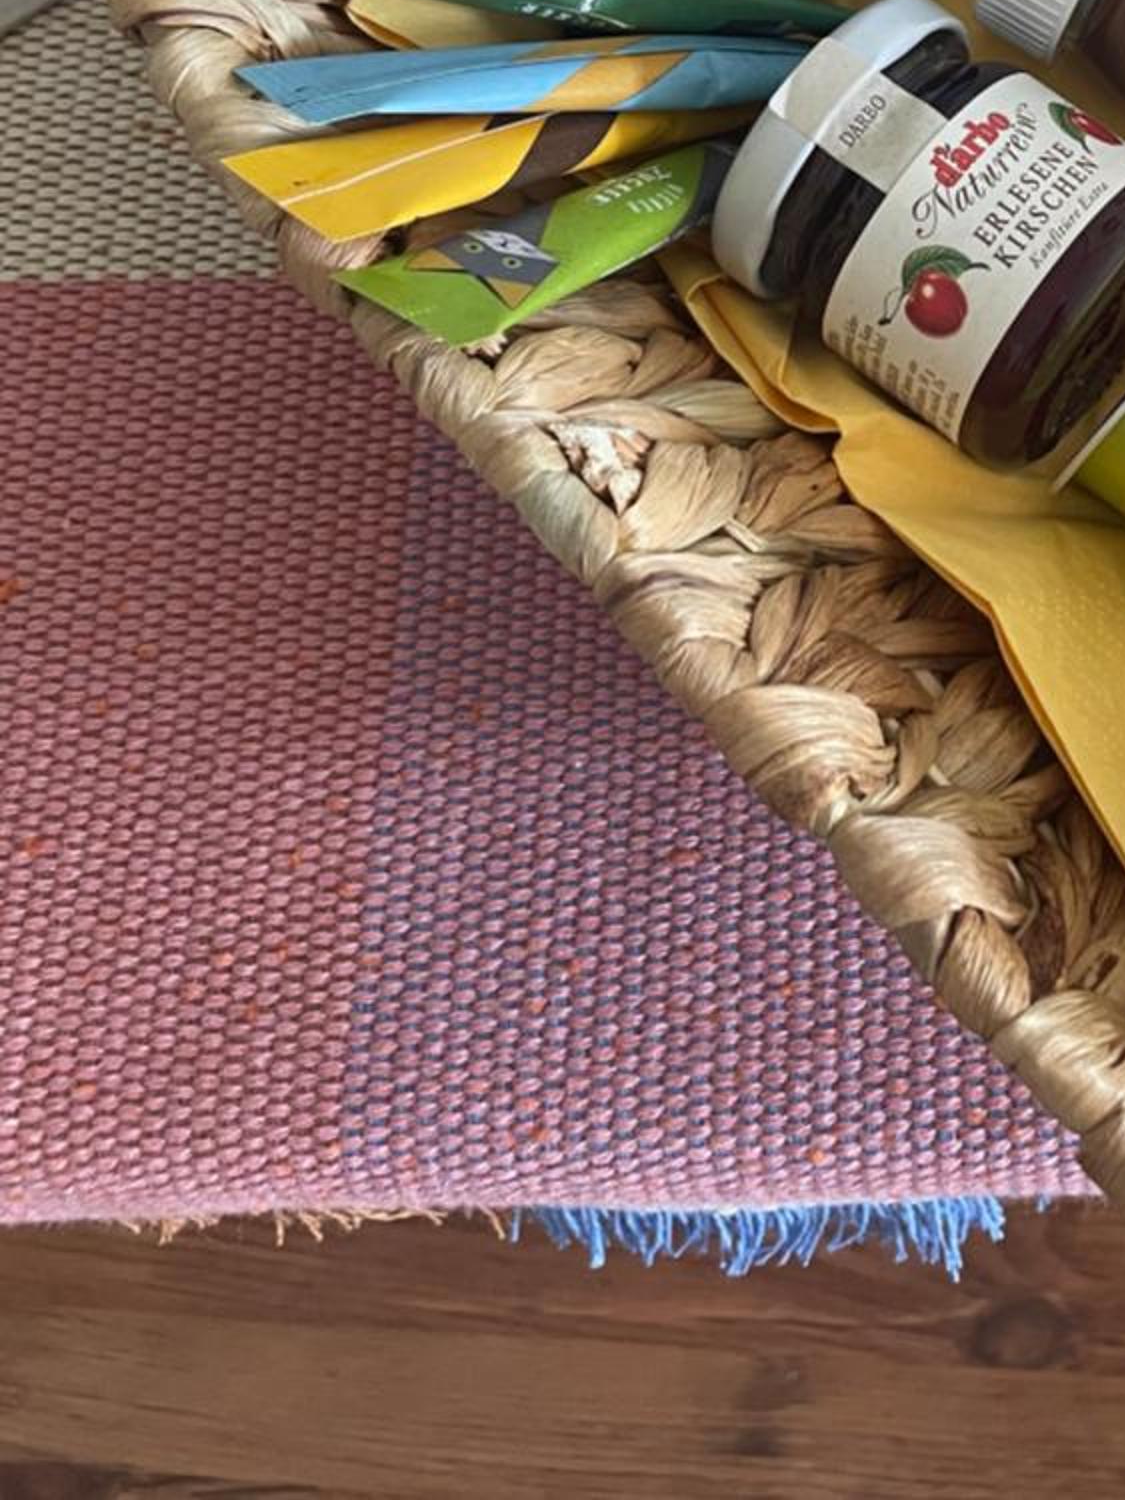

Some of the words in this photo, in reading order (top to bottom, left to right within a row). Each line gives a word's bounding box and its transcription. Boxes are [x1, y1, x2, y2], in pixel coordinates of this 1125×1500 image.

[838, 94, 887, 148] DARBO
[972, 140, 1075, 248] ERLESENE
[993, 154, 1099, 270] KIRSCHEN
